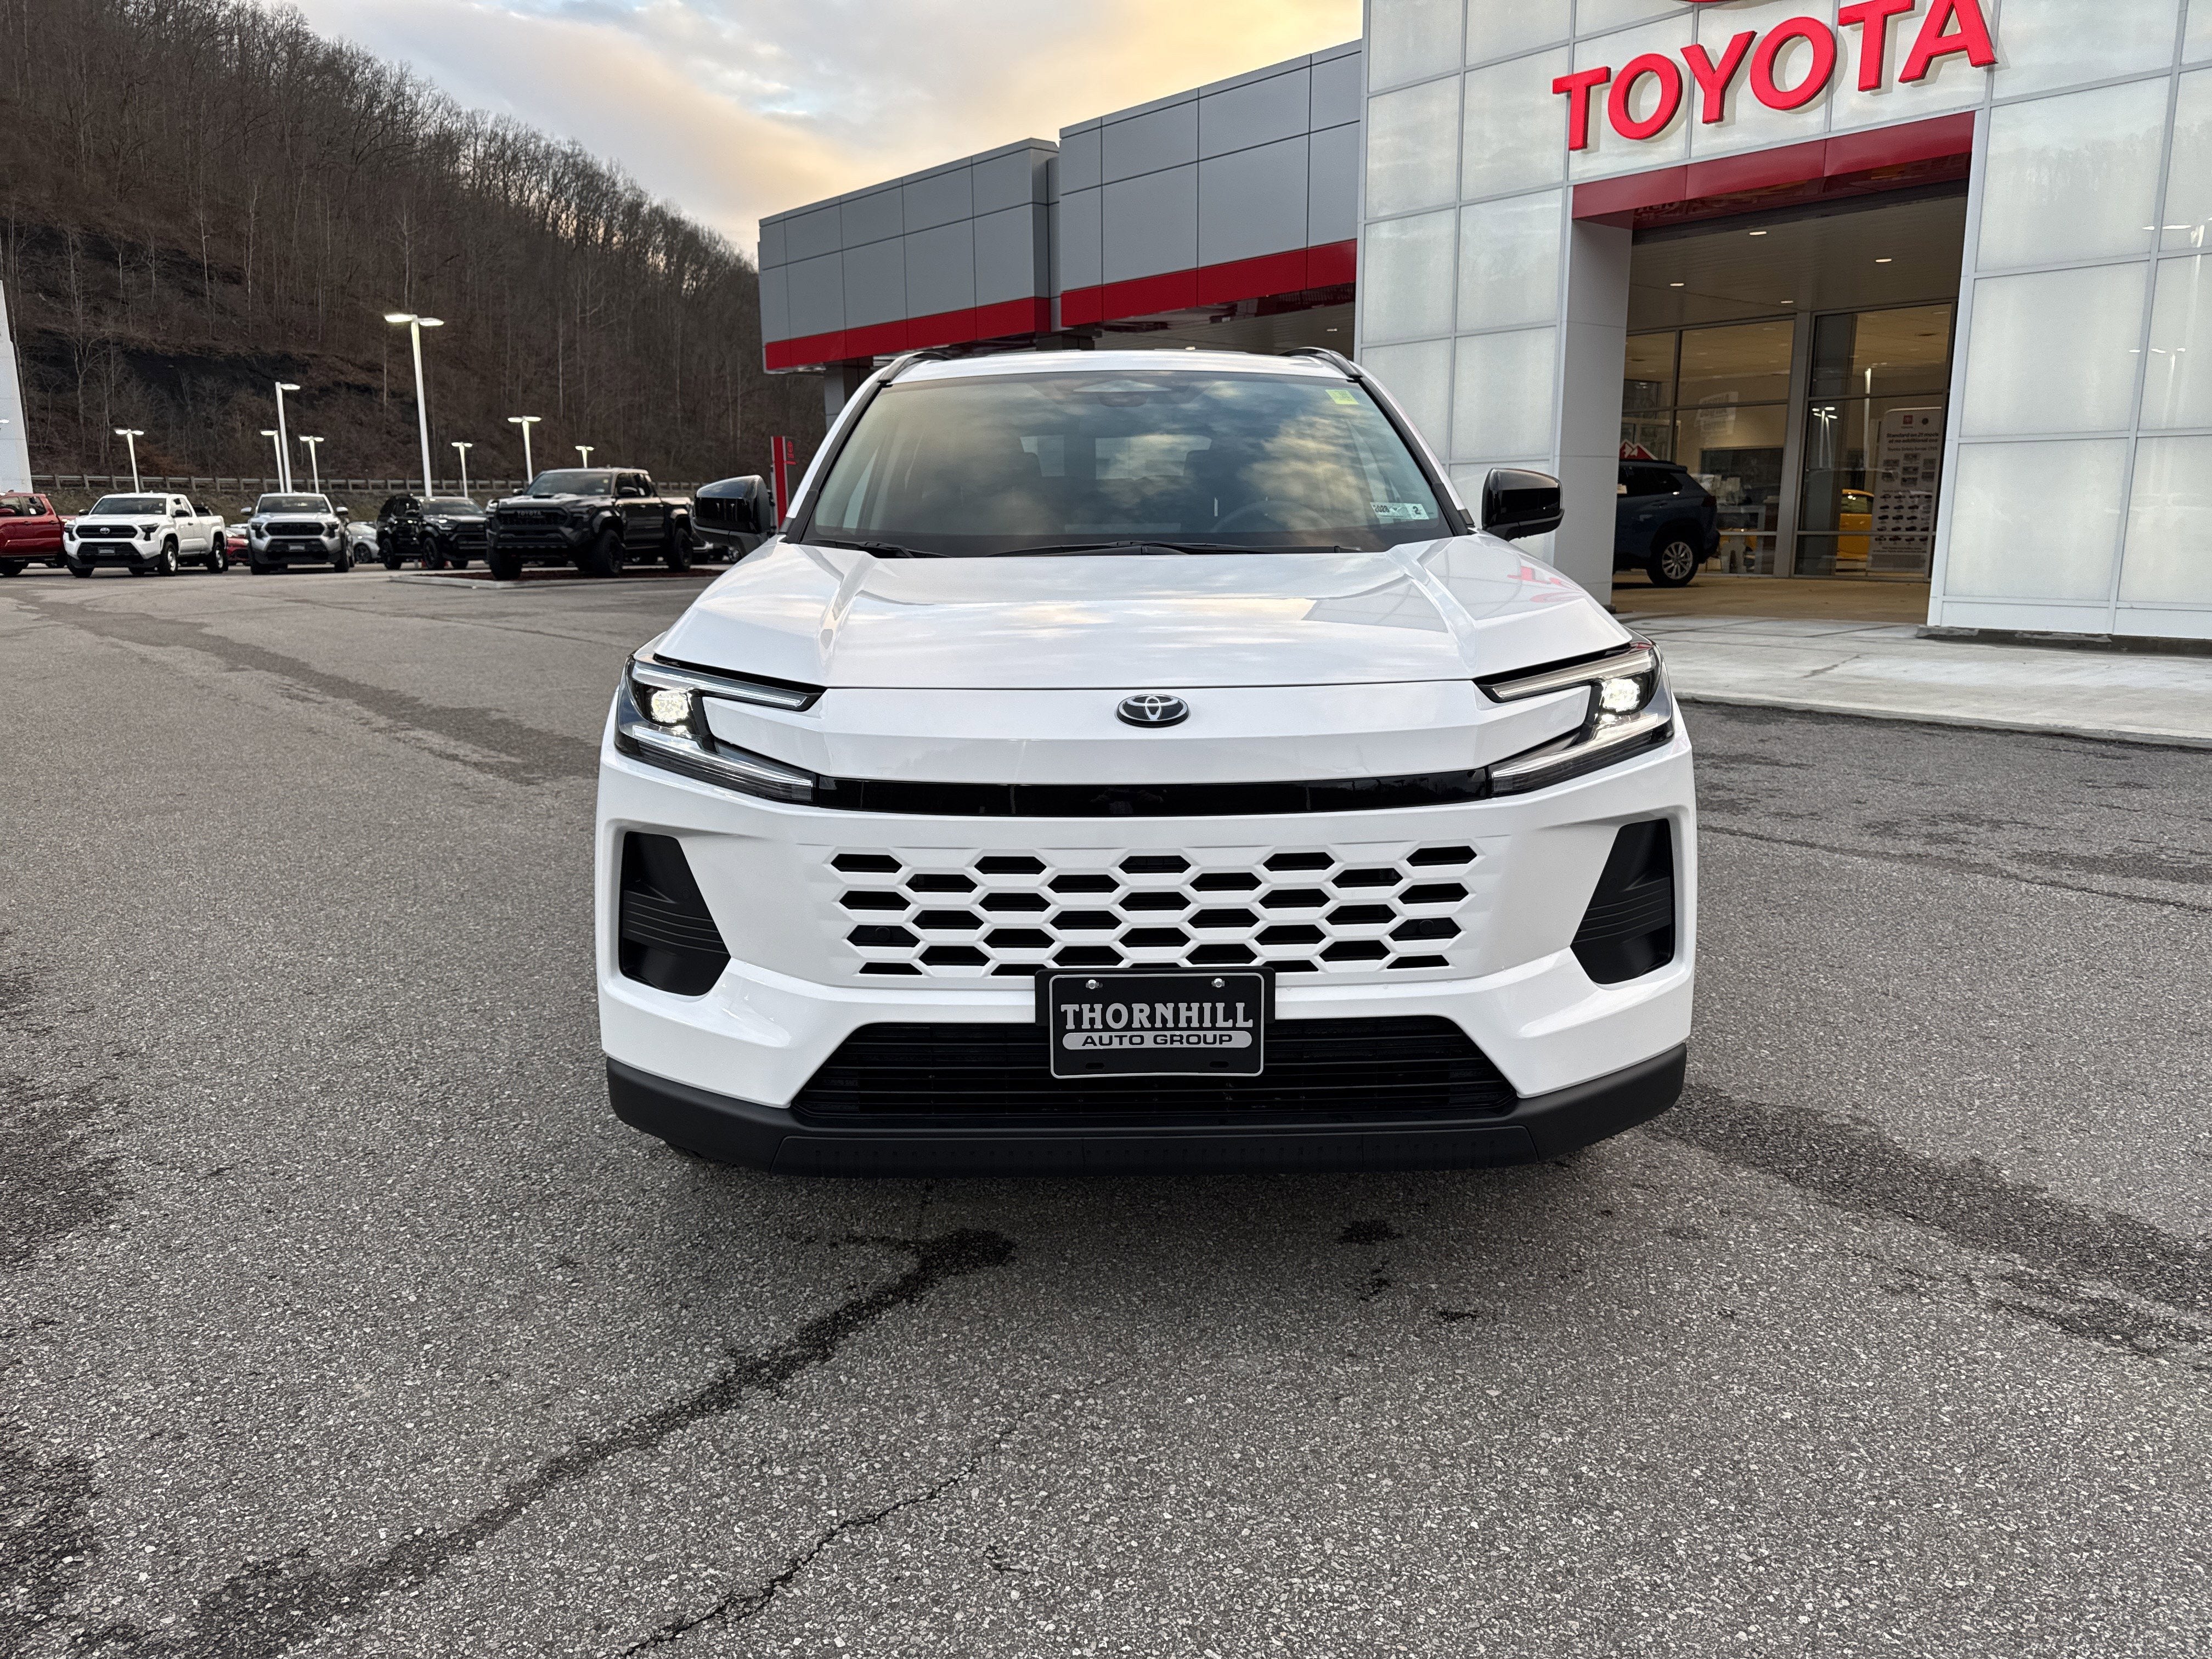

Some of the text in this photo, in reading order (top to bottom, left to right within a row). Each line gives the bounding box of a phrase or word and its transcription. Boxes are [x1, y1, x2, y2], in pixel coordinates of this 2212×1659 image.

[1553, 0, 1997, 150] TOYOTA
[1412, 506, 1421, 515] 2
[1060, 1002, 1253, 1030] THORNHILL
[1081, 1034, 1233, 1046] AUTO GROUP
